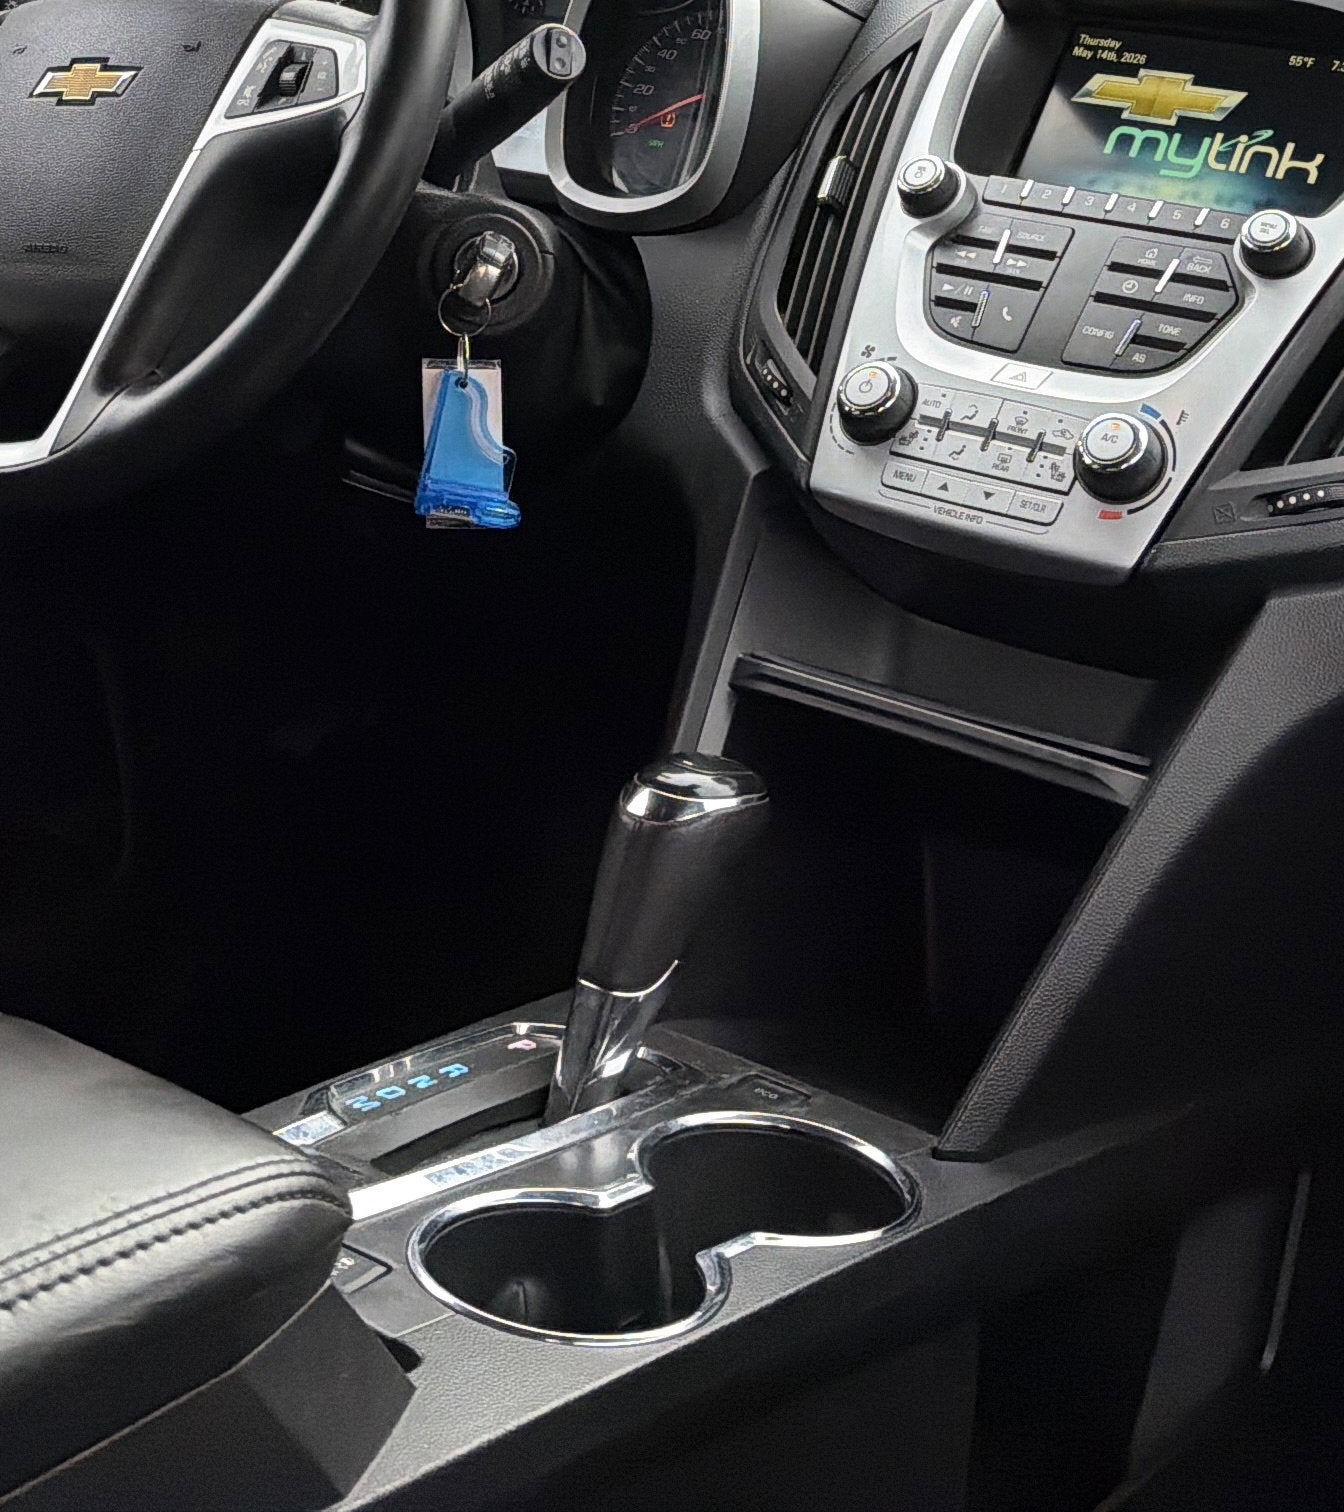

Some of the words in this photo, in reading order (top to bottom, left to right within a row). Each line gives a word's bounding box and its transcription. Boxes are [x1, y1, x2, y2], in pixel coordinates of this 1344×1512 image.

[691, 28, 712, 41] 60
[1079, 33, 1123, 50] Thursday
[657, 49, 678, 61] 40
[1072, 46, 1094, 61] May
[1288, 55, 1316, 69] 55°F
[633, 84, 655, 96] 20
[1040, 189, 1052, 199] 2
[1084, 196, 1094, 206] 3
[1127, 202, 1136, 213] 4
[1172, 210, 1182, 220] 5
[1220, 218, 1230, 229] 6
[1186, 263, 1211, 274] BACK
[1183, 294, 1205, 305] INFO
[1082, 326, 1114, 340] CONFIG
[1158, 324, 1183, 336] TONE
[921, 398, 942, 409] AUTO
[1007, 424, 1030, 435] FRONT
[1100, 433, 1119, 445] A/C
[992, 462, 1010, 473] REAR
[892, 469, 917, 483] MENU
[933, 505, 964, 520] VEHICLE
[964, 512, 984, 525] INFO
[507, 1039, 538, 1051] P
[439, 1063, 469, 1078] R
[407, 1074, 439, 1088] N
[376, 1085, 407, 1100] D
